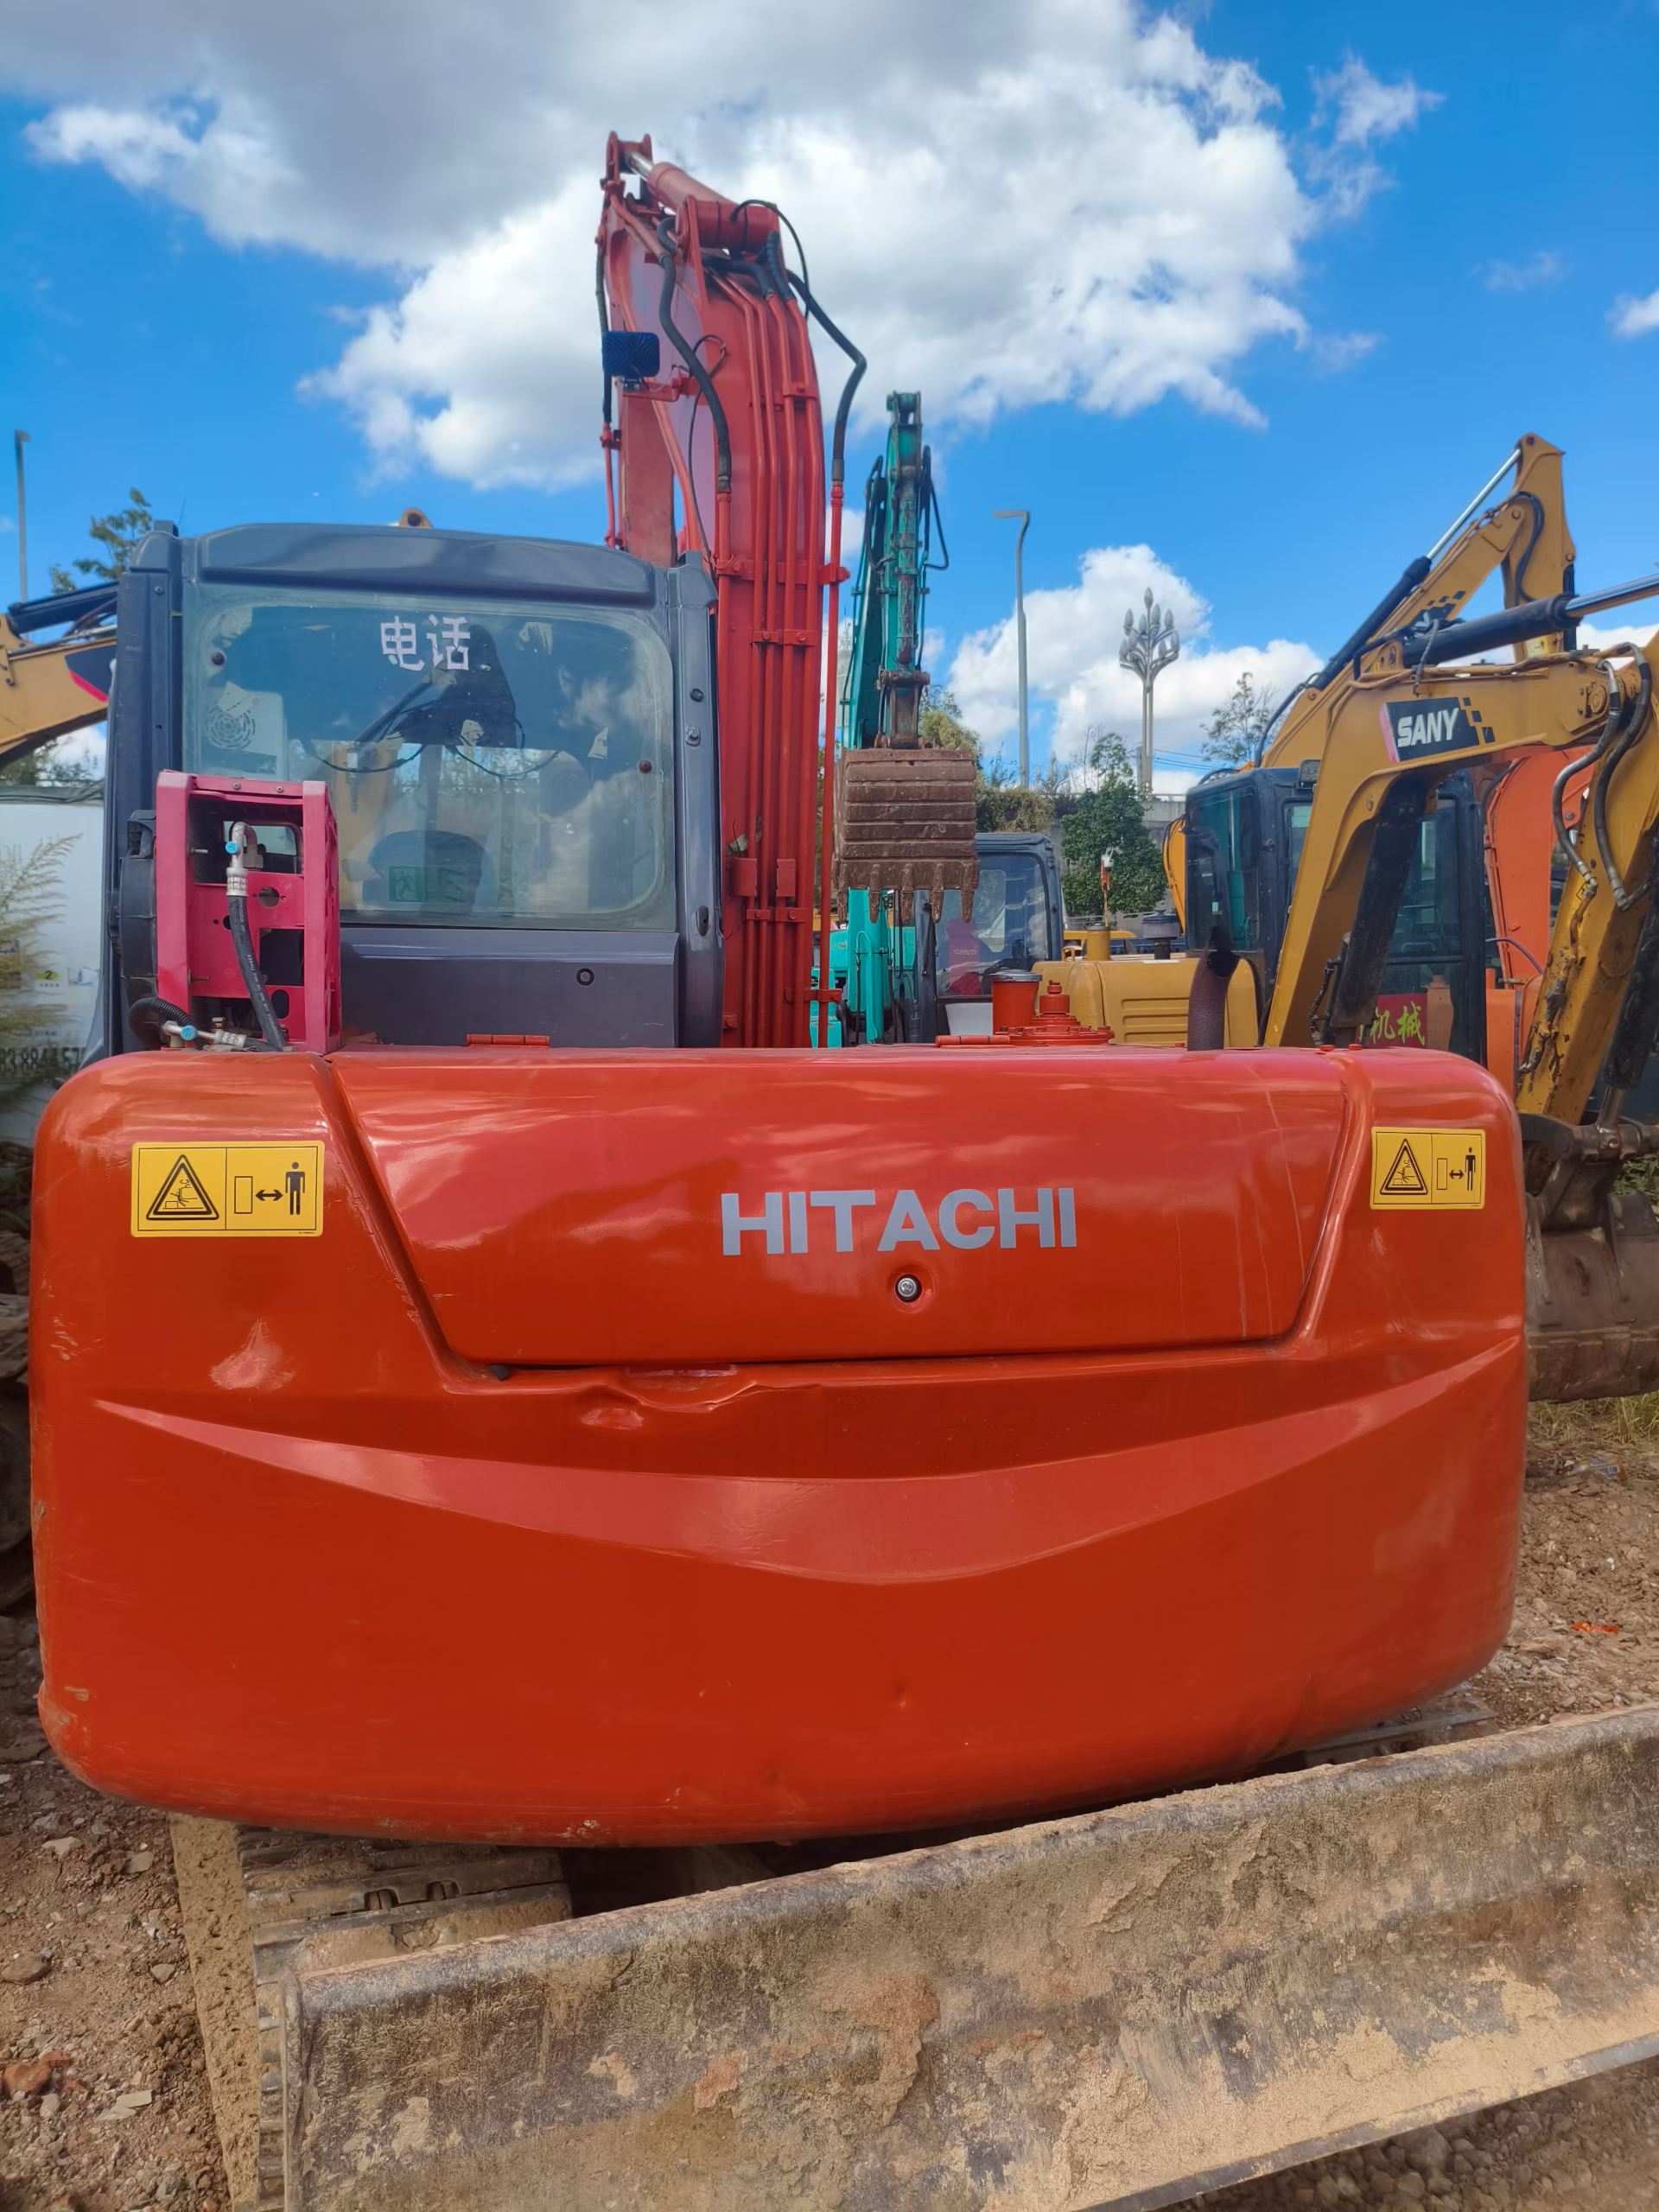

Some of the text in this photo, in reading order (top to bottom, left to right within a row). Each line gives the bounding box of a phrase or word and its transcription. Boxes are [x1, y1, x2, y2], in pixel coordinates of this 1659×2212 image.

[380, 614, 471, 671] 电话
[1397, 707, 1459, 748] SANY
[1358, 1001, 1426, 1046] 机械
[721, 1187, 1077, 1256] HITACHI
